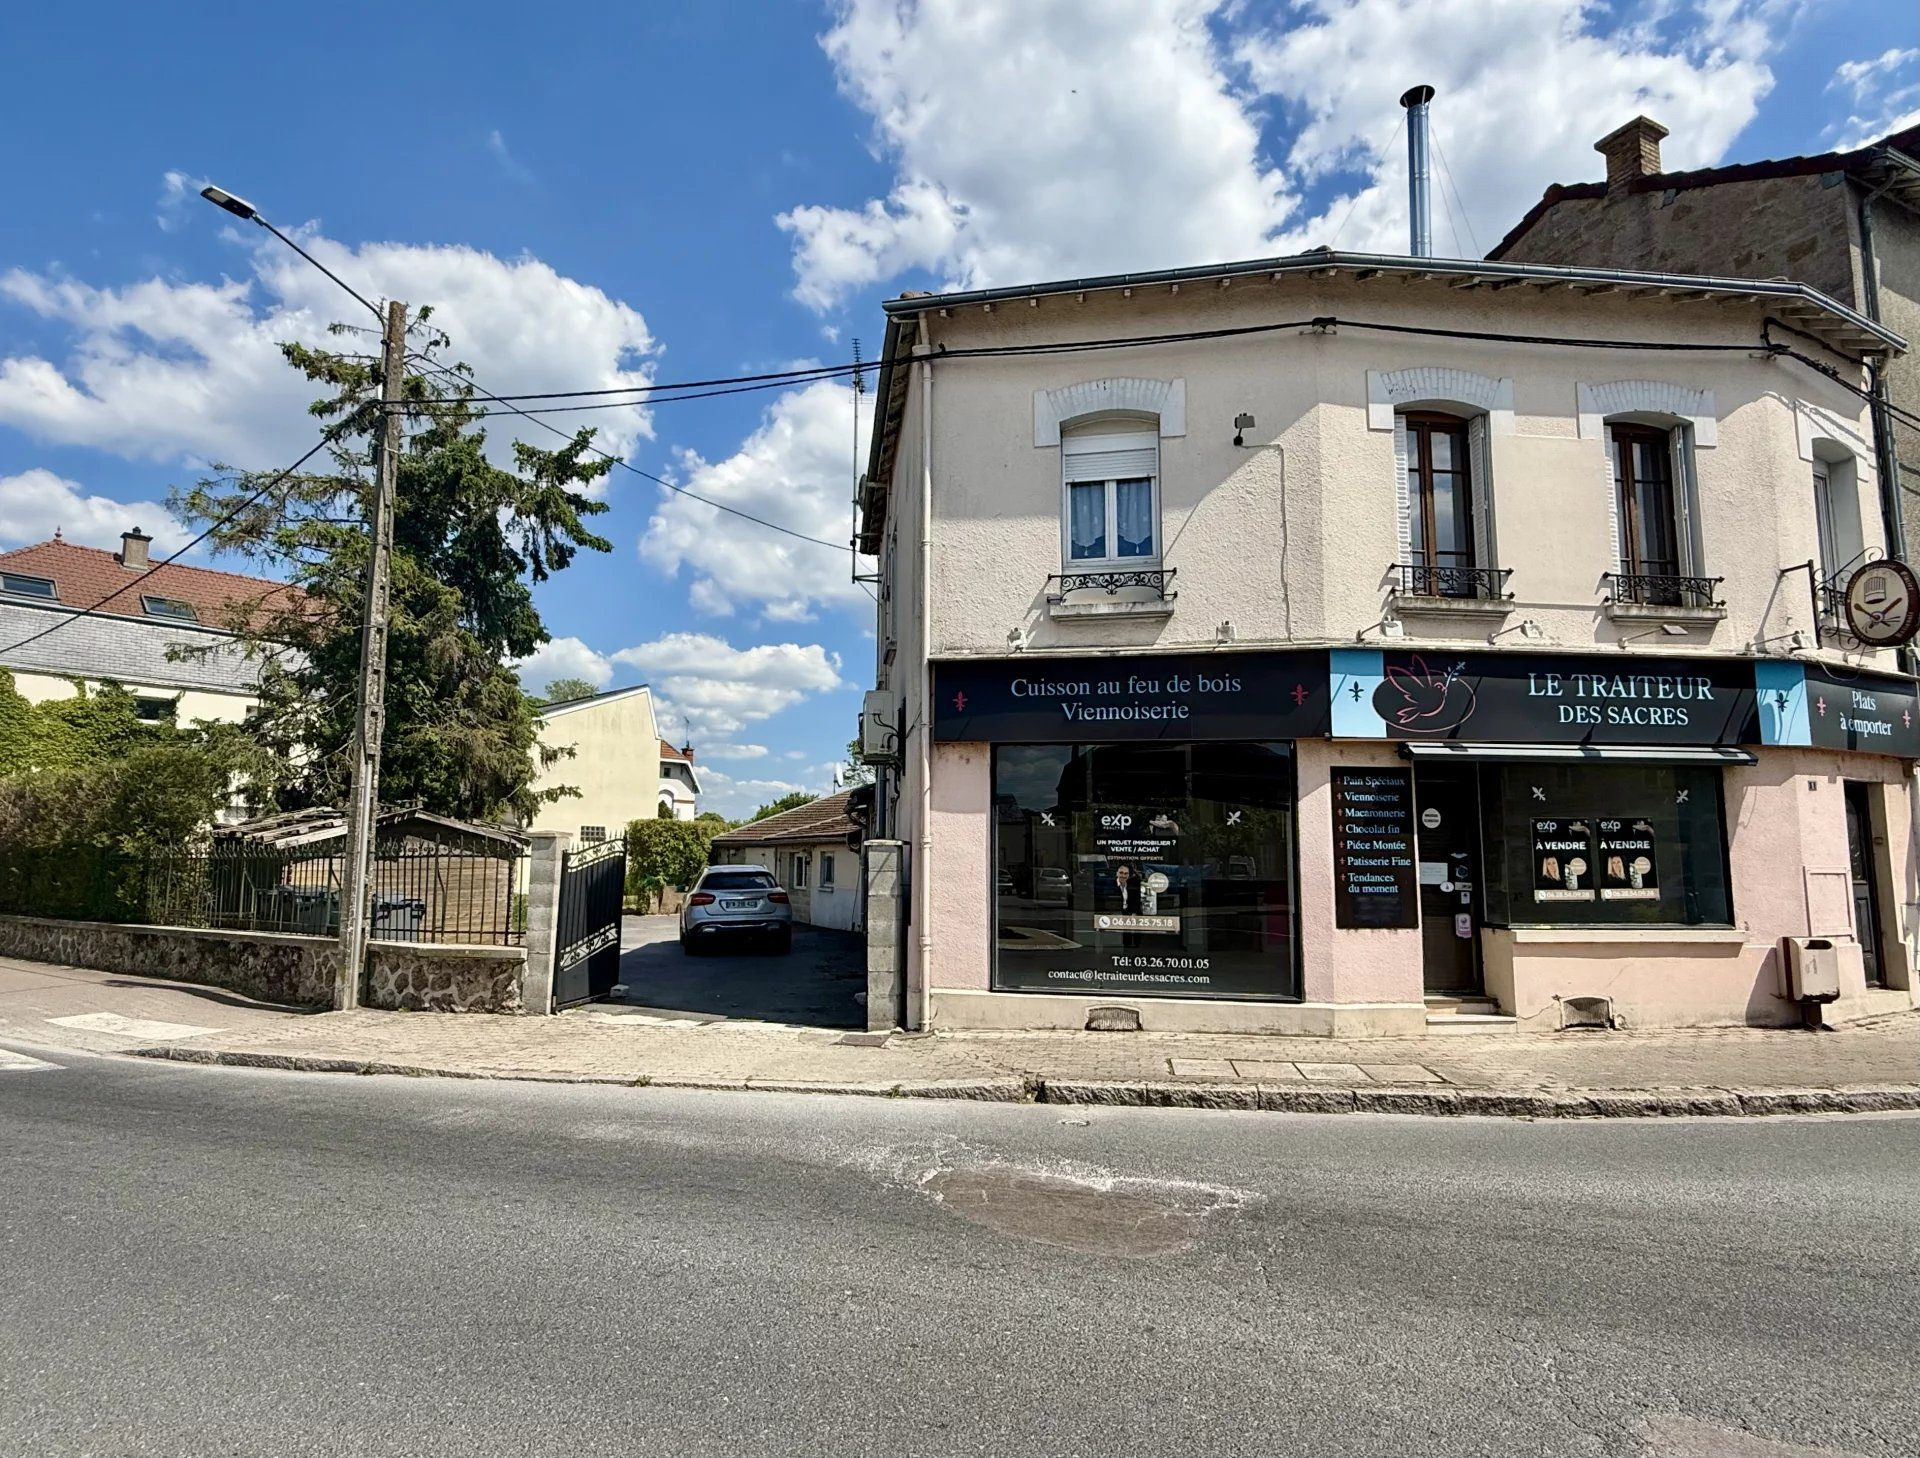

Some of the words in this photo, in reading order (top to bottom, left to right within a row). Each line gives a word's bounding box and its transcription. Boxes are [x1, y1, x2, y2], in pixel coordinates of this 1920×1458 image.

[1010, 677, 1090, 697] Cuisson
[1097, 680, 1121, 695] au
[1128, 675, 1161, 694] feu
[1167, 674, 1191, 694] de
[1198, 673, 1242, 693] bois
[1528, 673, 1563, 697] LE
[1570, 673, 1715, 700] TRAITEUR
[1852, 690, 1876, 711] Plats
[1061, 700, 1190, 722] Viennoiserie
[1558, 705, 1602, 724] DES
[1608, 706, 1689, 726] SACRES
[1840, 714, 1847, 730] à
[1849, 717, 1892, 738] emporter
[1343, 776, 1364, 786] Pain
[1365, 776, 1405, 788] Spéciaux
[1344, 792, 1399, 801] Viennoiserie
[1345, 808, 1405, 818] Macaronnerie
[1345, 824, 1385, 834] Chocolat
[1387, 824, 1400, 834] fin
[1372, 840, 1407, 850] Montée
[1536, 838, 1543, 850] À
[1545, 841, 1587, 850] VENDRE
[1609, 840, 1651, 849] VENDRE
[1347, 856, 1390, 866] Patisserie
[1391, 856, 1412, 866] Fine
[1348, 873, 1395, 882] Tendances
[1348, 884, 1360, 893] du
[1362, 885, 1399, 893] moment
[1112, 917, 1173, 927] 06.63.25.75.18
[1112, 955, 1132, 967] Tél:
[1134, 956, 1210, 969] 03.26.70.01.05
[1048, 968, 1210, 984] contact@letraiteurdessacres.com
